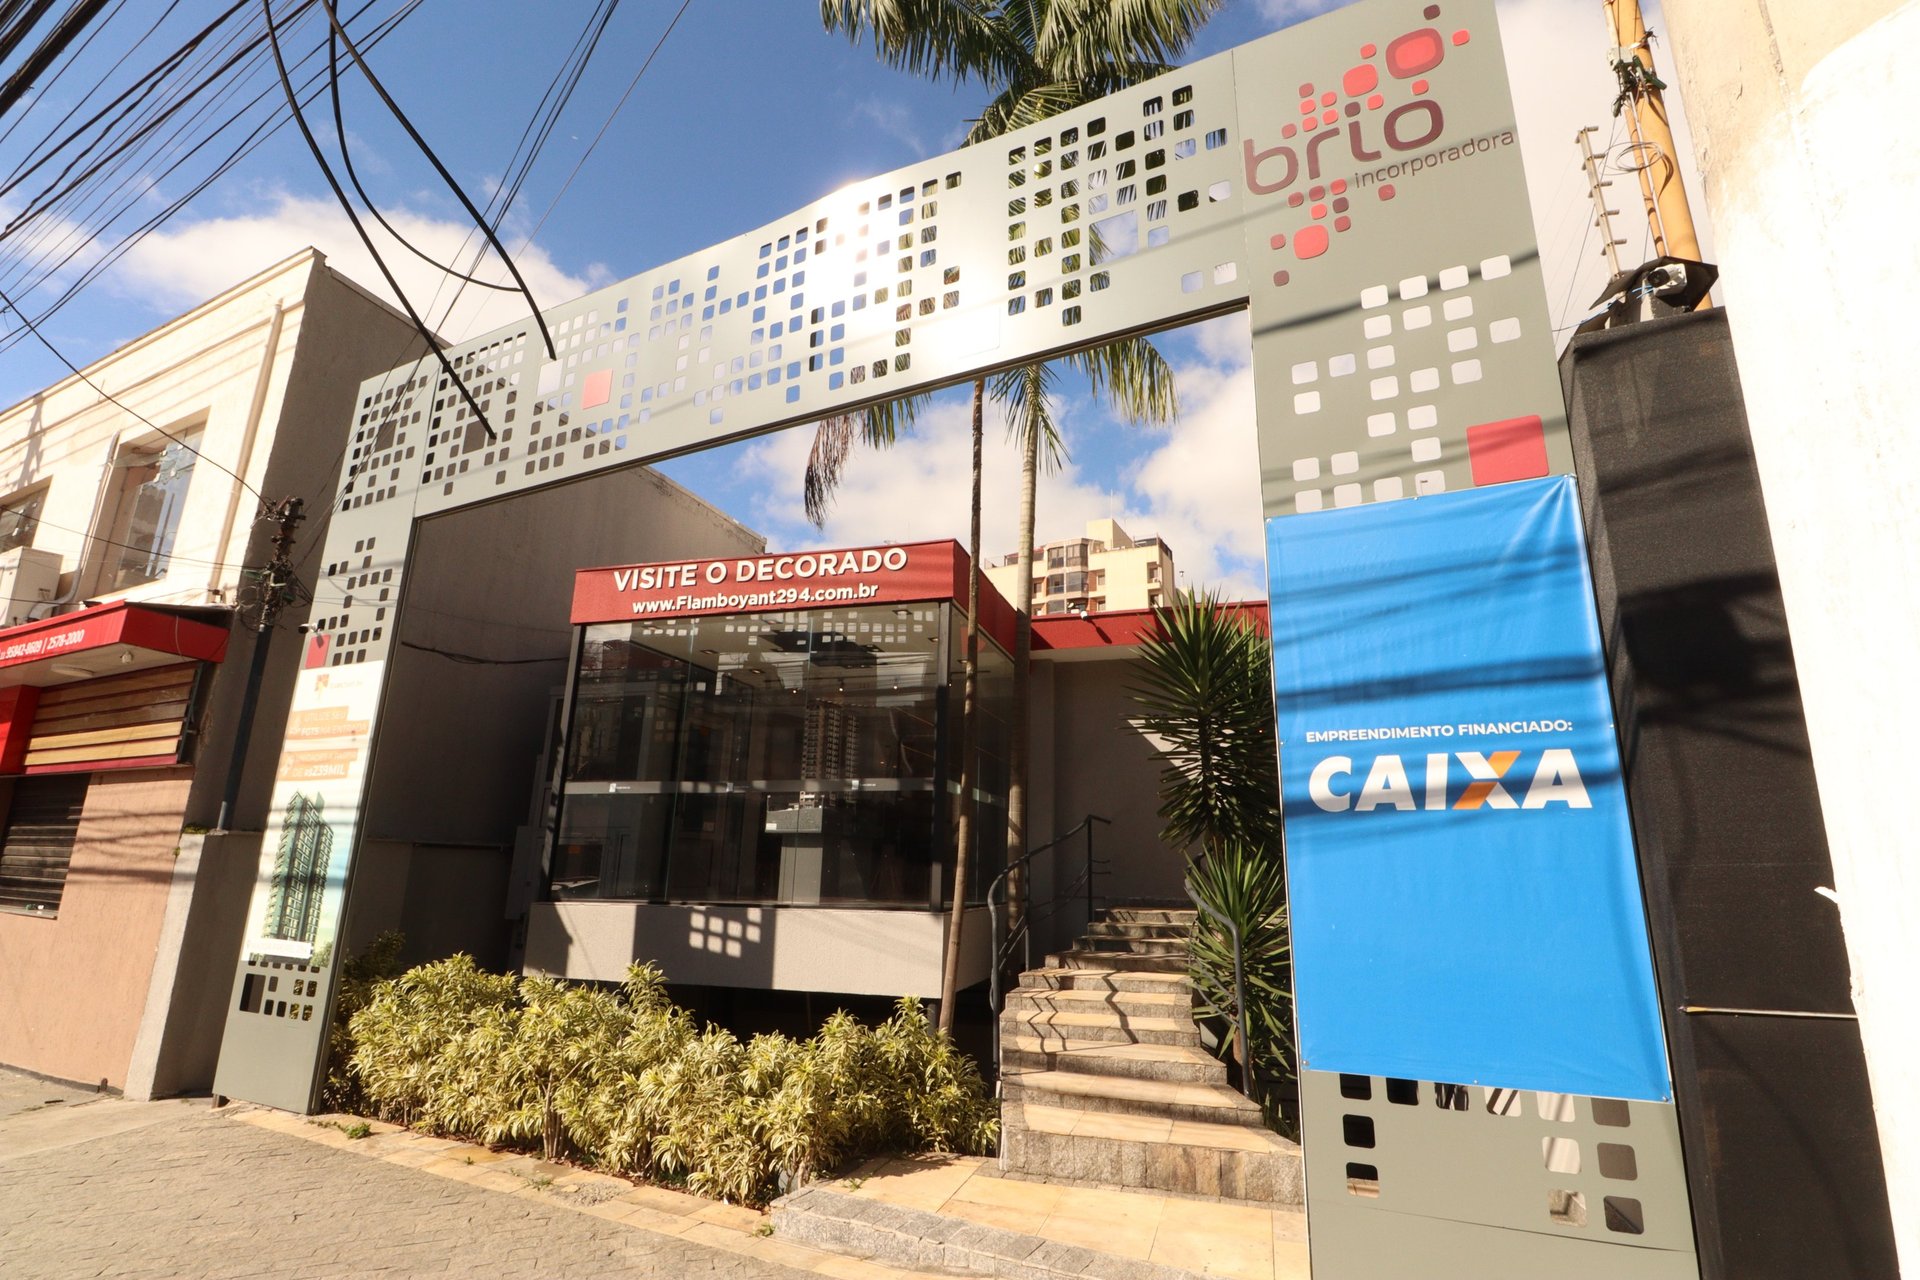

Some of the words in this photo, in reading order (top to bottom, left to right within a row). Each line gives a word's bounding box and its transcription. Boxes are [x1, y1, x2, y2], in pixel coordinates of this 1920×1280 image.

[1243, 99, 1444, 196] brio
[1354, 130, 1514, 188] incorporadora
[613, 563, 698, 592] VISITE
[705, 561, 728, 585] O
[736, 547, 908, 583] DECORADO
[632, 582, 879, 614] www.Flamboyant294.com.br
[301, 727, 320, 736] FGTS
[1306, 725, 1455, 743] EMPREENDIMENTO
[1458, 719, 1573, 736] FINANCIADO:
[1308, 748, 1593, 812] CAIXA
